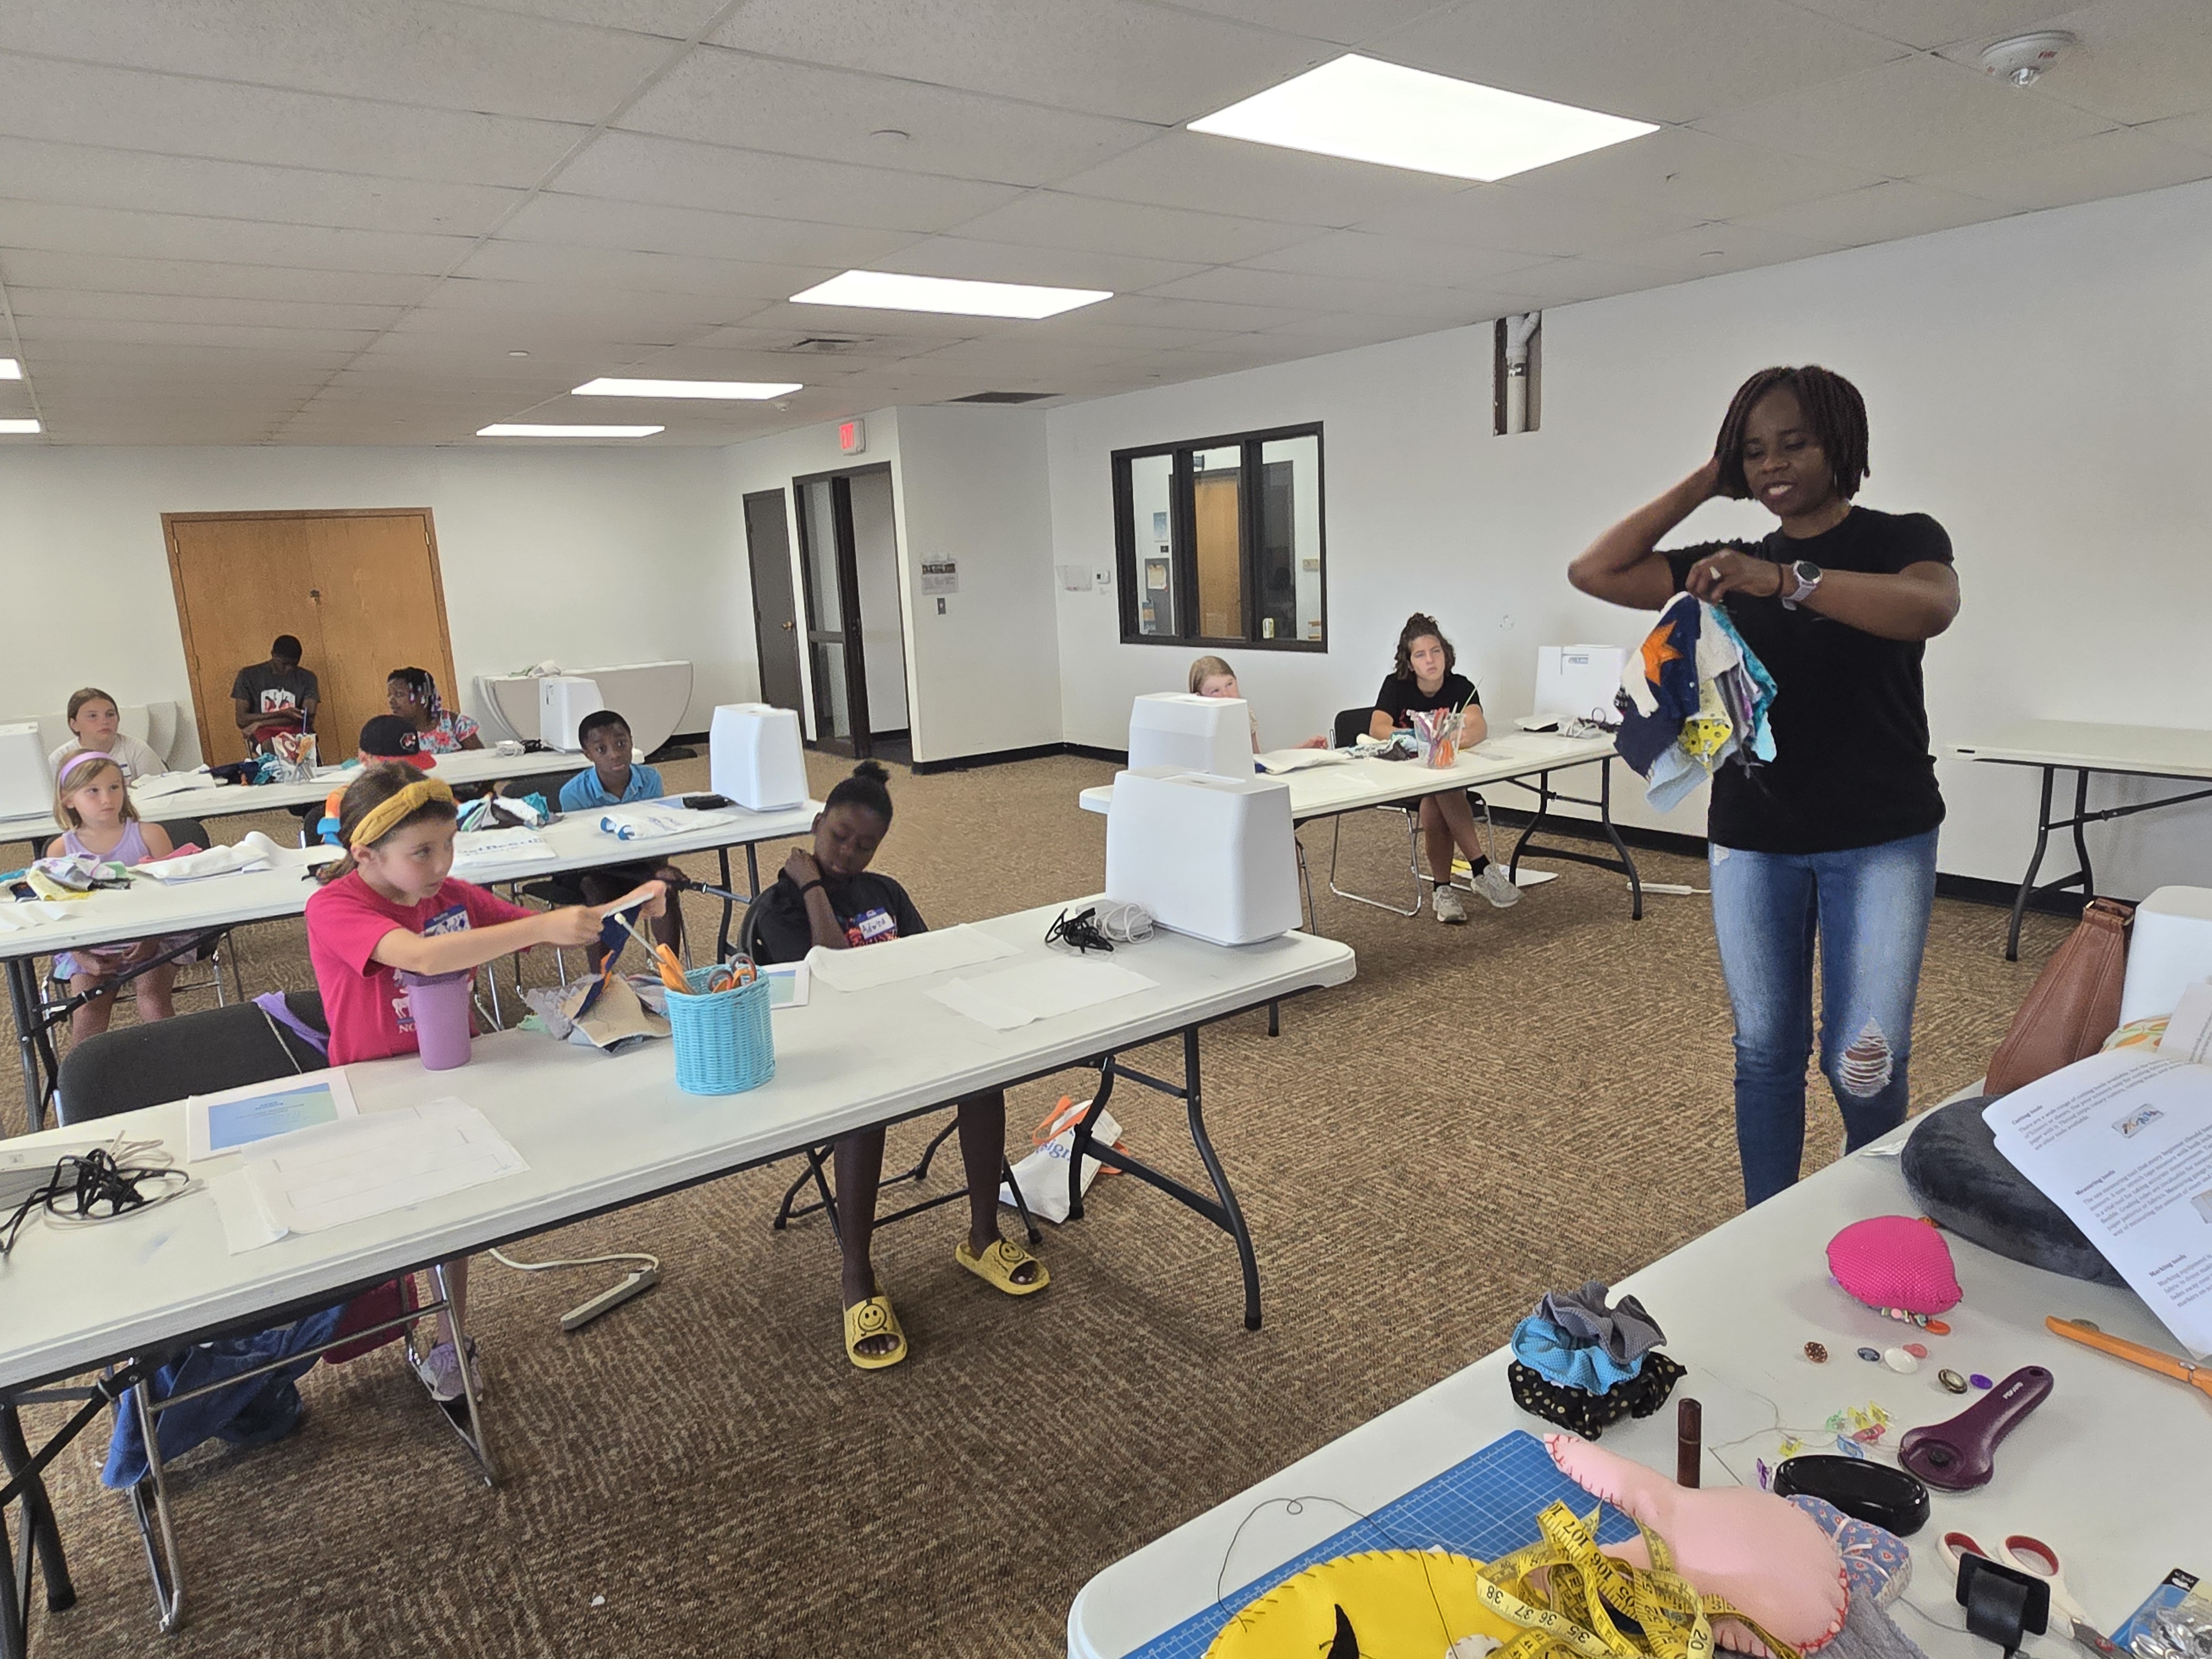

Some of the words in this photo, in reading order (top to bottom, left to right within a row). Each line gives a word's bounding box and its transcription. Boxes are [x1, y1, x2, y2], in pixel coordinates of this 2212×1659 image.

[2148, 1262, 2173, 1276] Marking
[2171, 1254, 2186, 1264] tools
[1563, 1521, 1590, 1548] 107
[1590, 1552, 1614, 1581] 106
[1486, 1585, 1504, 1604] 38
[1514, 1605, 1534, 1620] 37
[1538, 1611, 1557, 1626] 36
[1567, 1625, 1590, 1644] 35
[1690, 1629, 1708, 1651] 20
